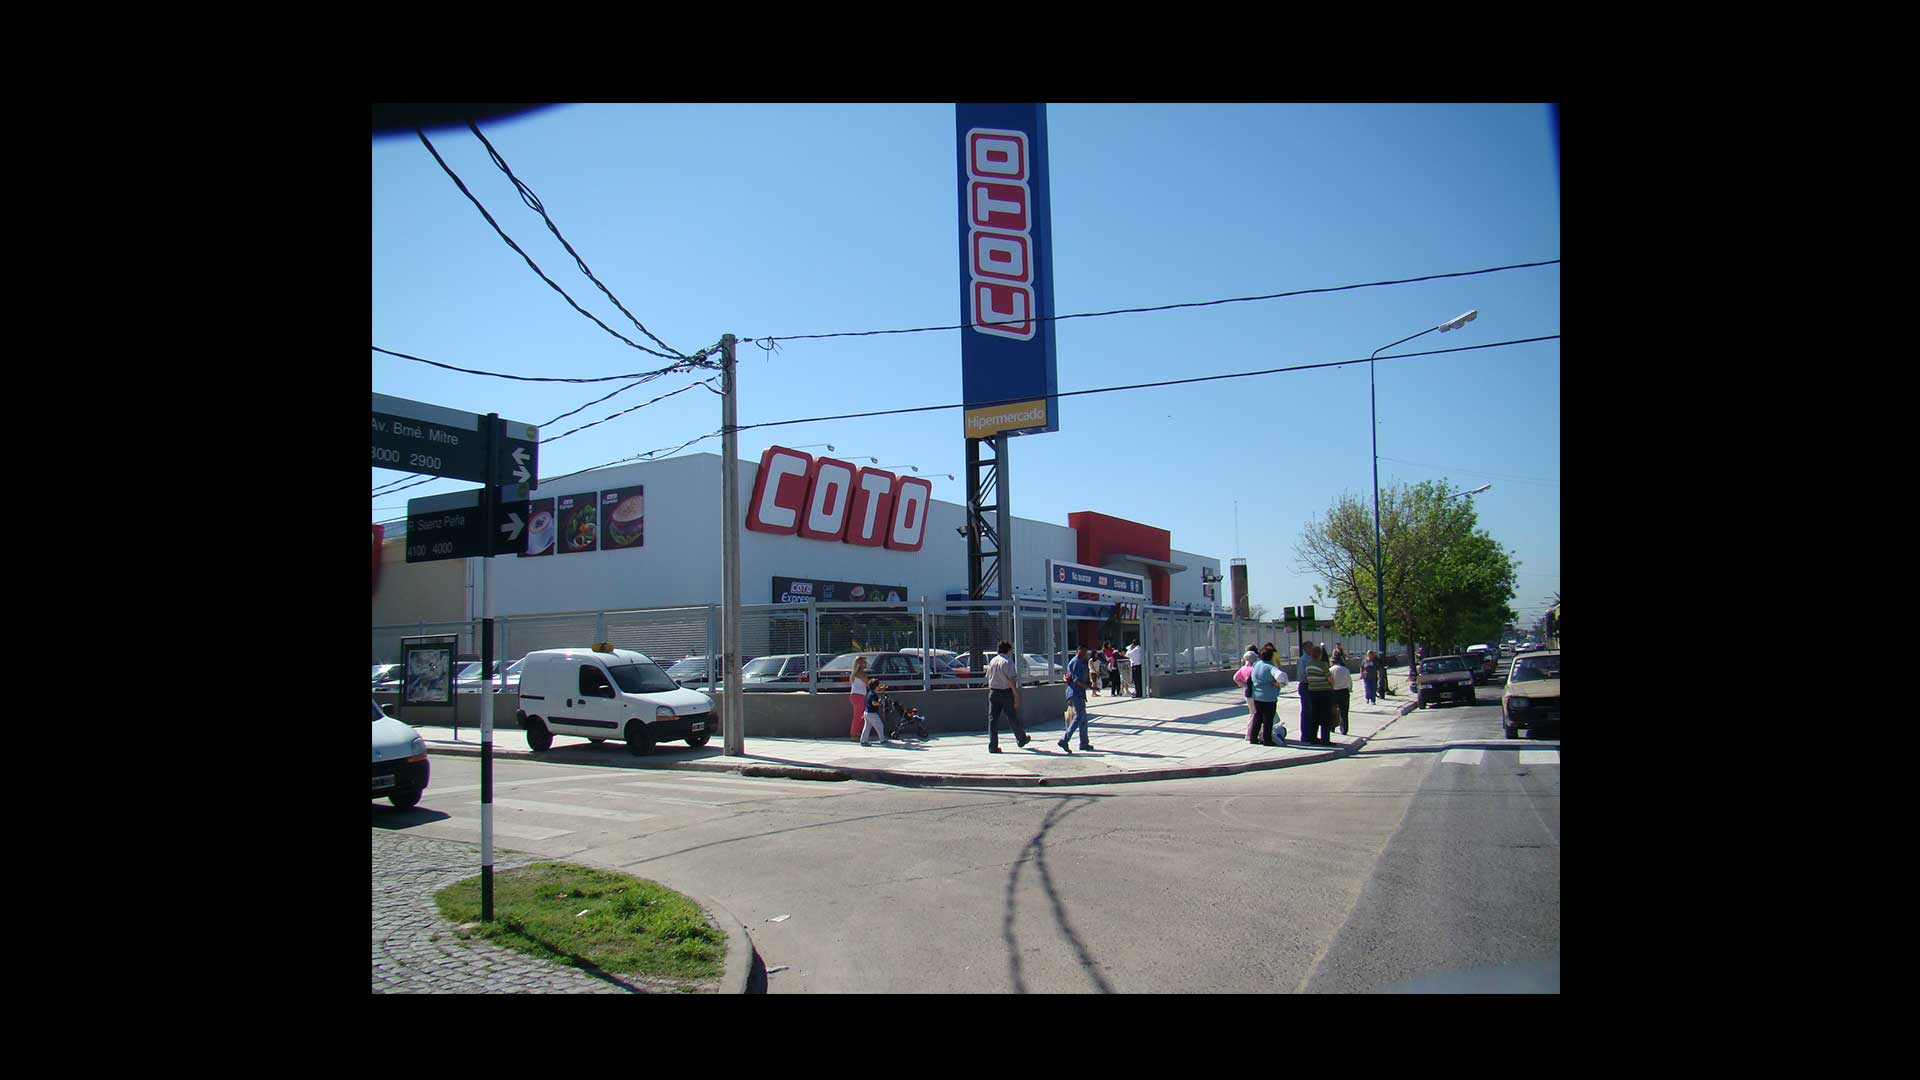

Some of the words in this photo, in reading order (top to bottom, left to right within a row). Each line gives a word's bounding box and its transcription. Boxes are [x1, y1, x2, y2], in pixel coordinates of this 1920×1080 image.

[969, 130, 1032, 336] COTO
[967, 406, 1046, 430] Hipermercado
[428, 429, 459, 446] Mitre
[409, 453, 442, 470] 2900
[755, 451, 929, 546] COTO
[790, 582, 813, 595] COTO
